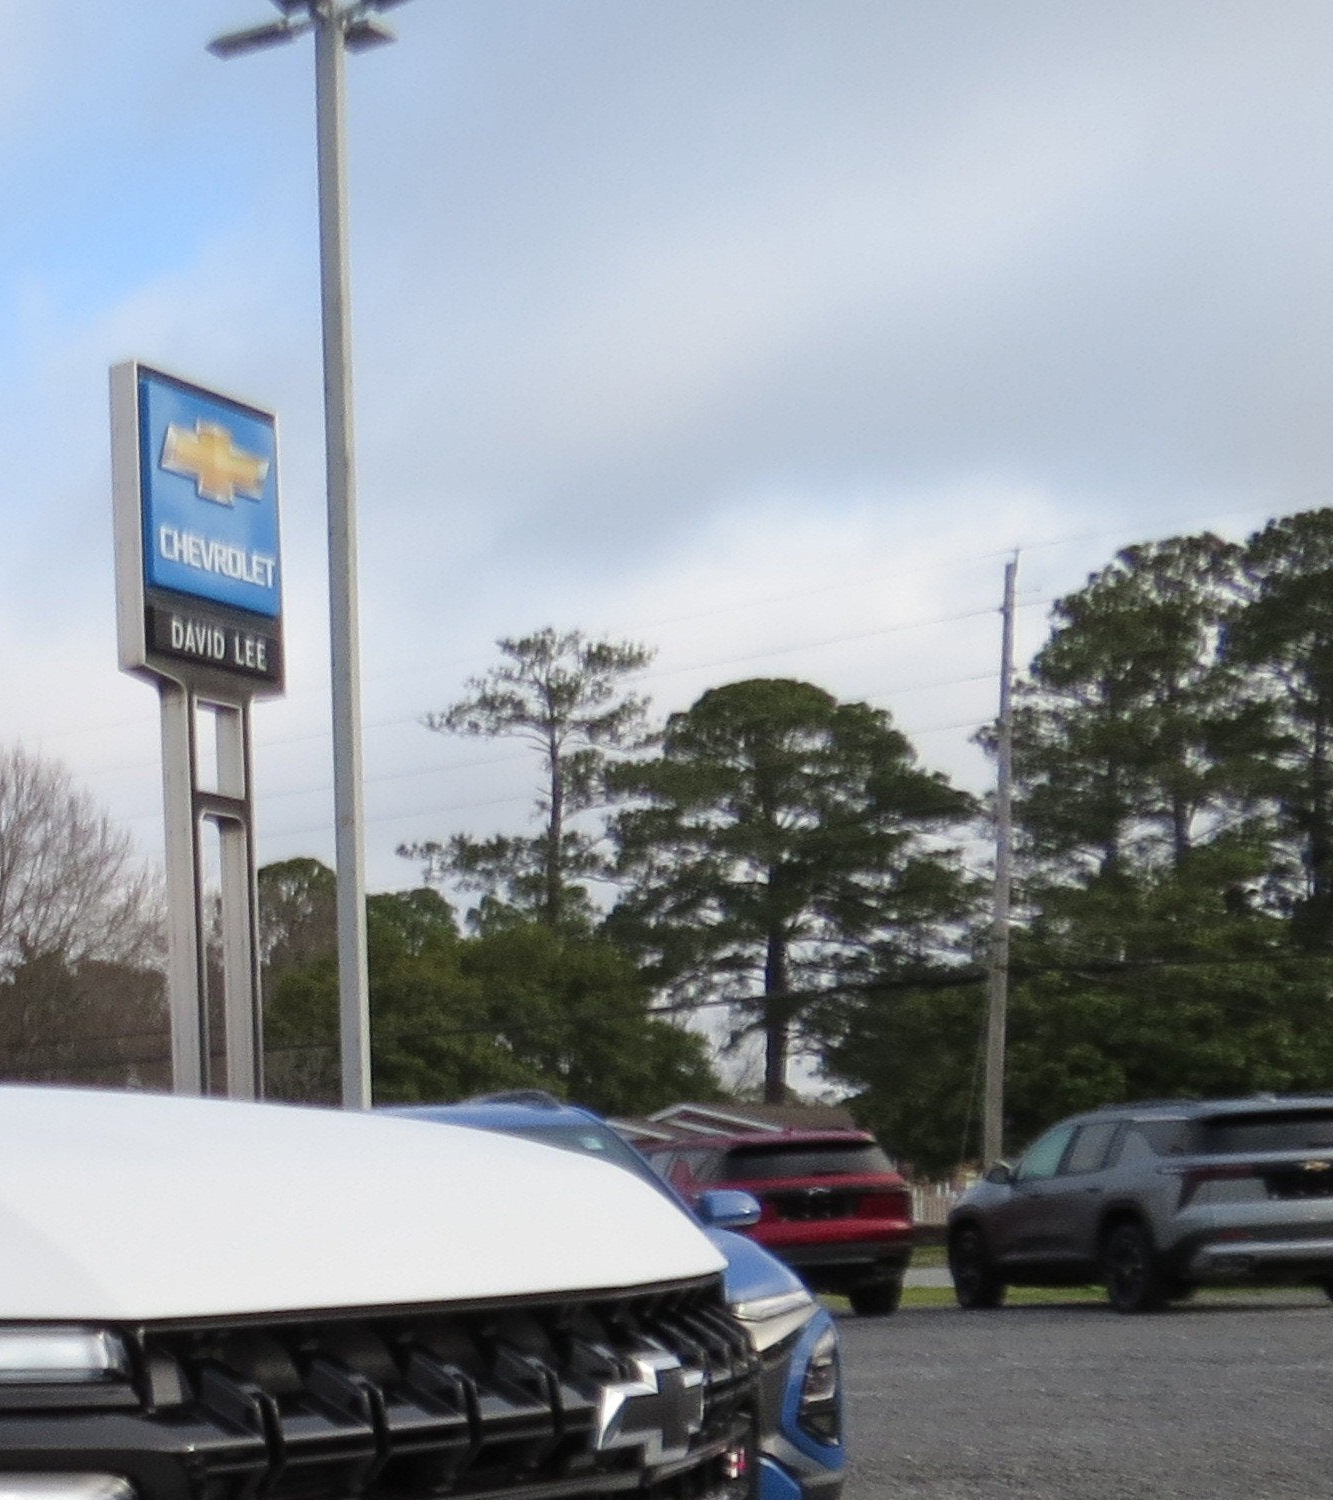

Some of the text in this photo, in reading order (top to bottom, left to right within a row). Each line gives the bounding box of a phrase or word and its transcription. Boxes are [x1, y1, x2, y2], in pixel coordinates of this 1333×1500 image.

[159, 526, 276, 588] CHEVROLET
[171, 616, 268, 672] DAVID LEE
